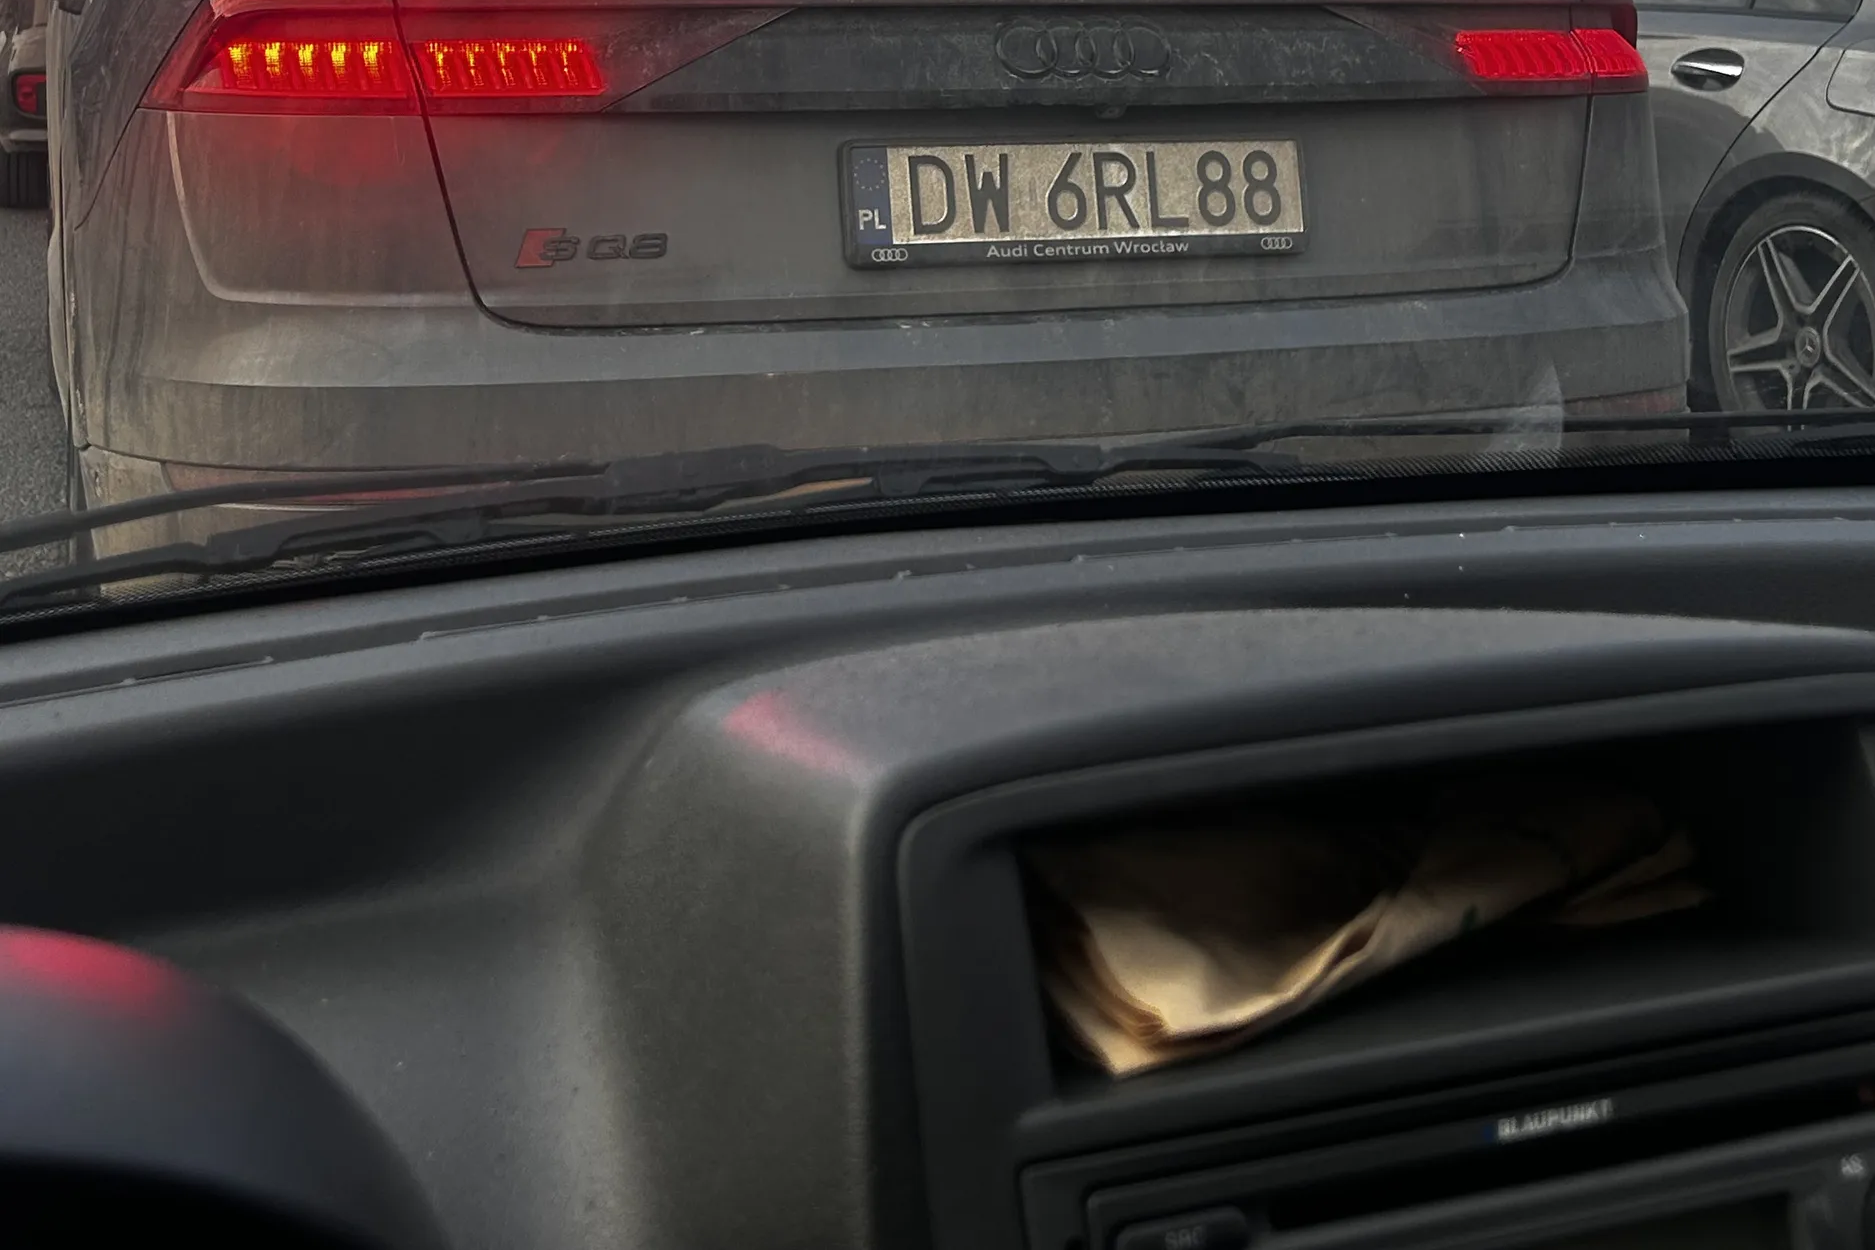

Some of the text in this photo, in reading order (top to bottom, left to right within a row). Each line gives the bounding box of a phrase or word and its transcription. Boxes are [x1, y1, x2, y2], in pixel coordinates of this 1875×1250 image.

[908, 149, 1282, 235] DW 6RL88
[858, 208, 887, 230] PL
[986, 240, 1190, 258] Audi Centrum Wrocław
[1498, 1098, 1615, 1143] BLAUPUNKT
